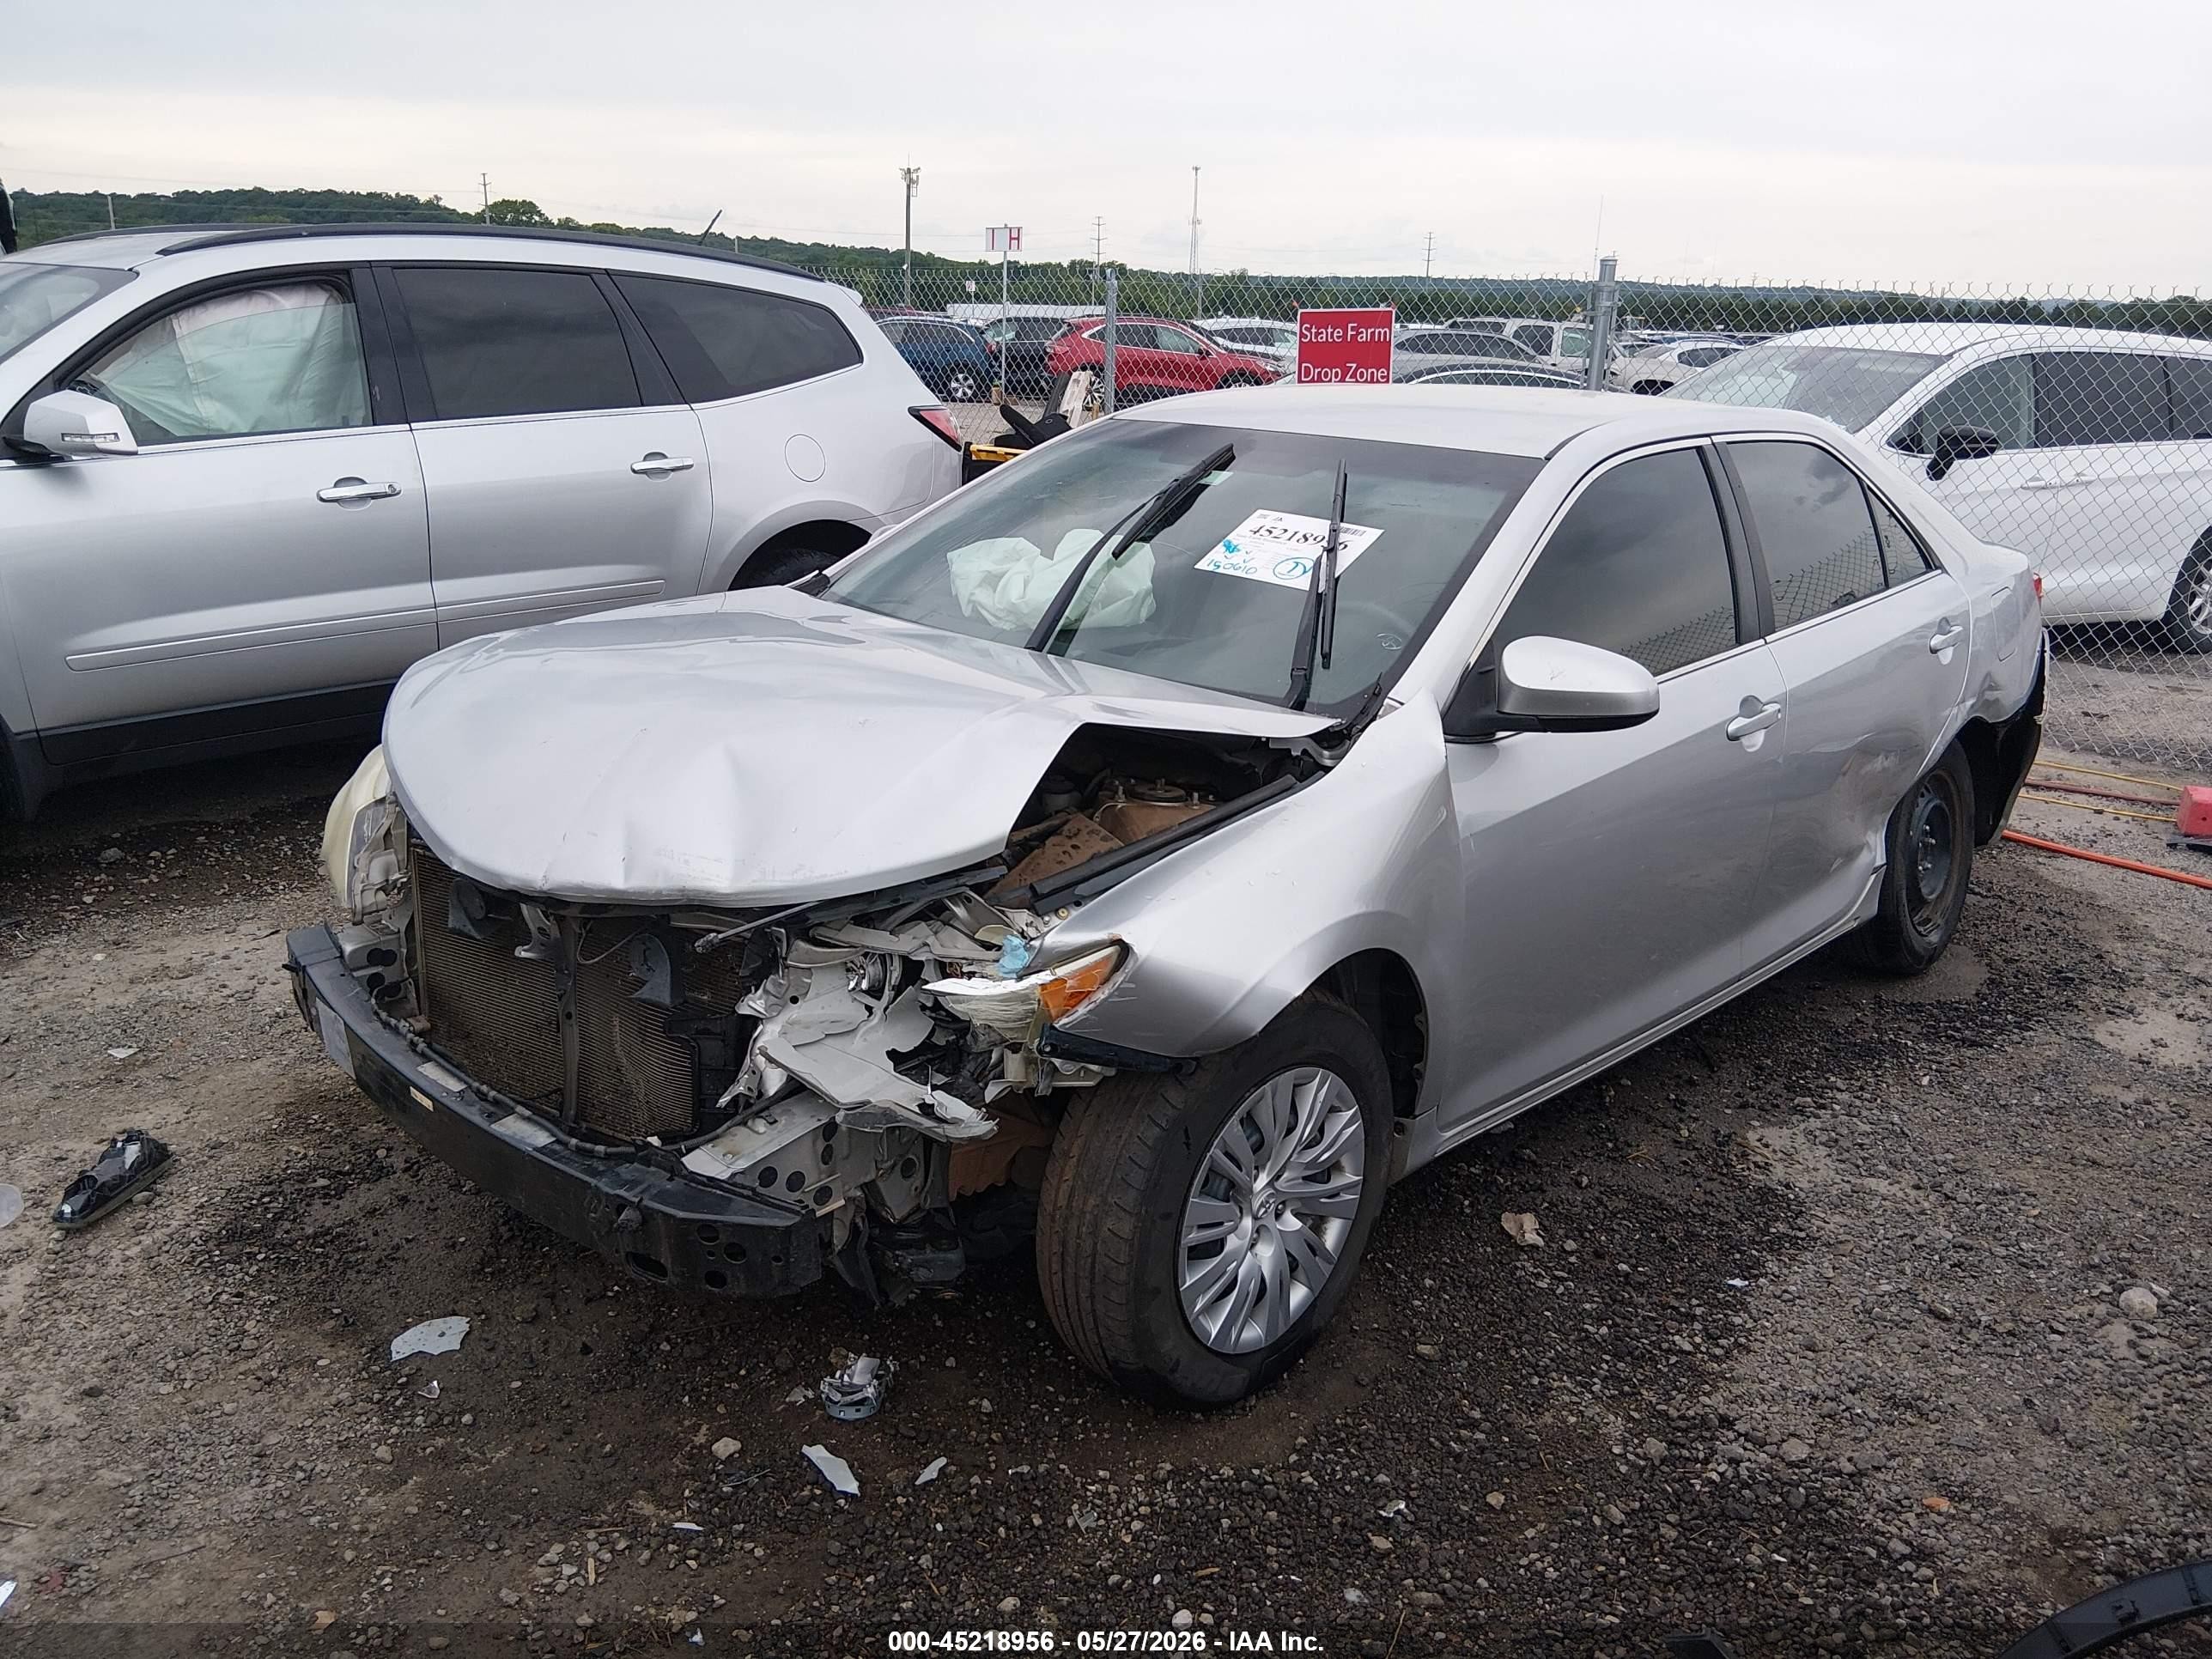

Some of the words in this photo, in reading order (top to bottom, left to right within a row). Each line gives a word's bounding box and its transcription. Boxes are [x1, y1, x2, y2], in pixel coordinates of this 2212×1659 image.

[1009, 228, 1020, 250] H
[1301, 324, 1343, 343] State
[1347, 323, 1389, 343] Farm
[1301, 363, 1341, 383] Drop
[1345, 363, 1388, 382] Zone
[1249, 525, 1352, 551] 4521896
